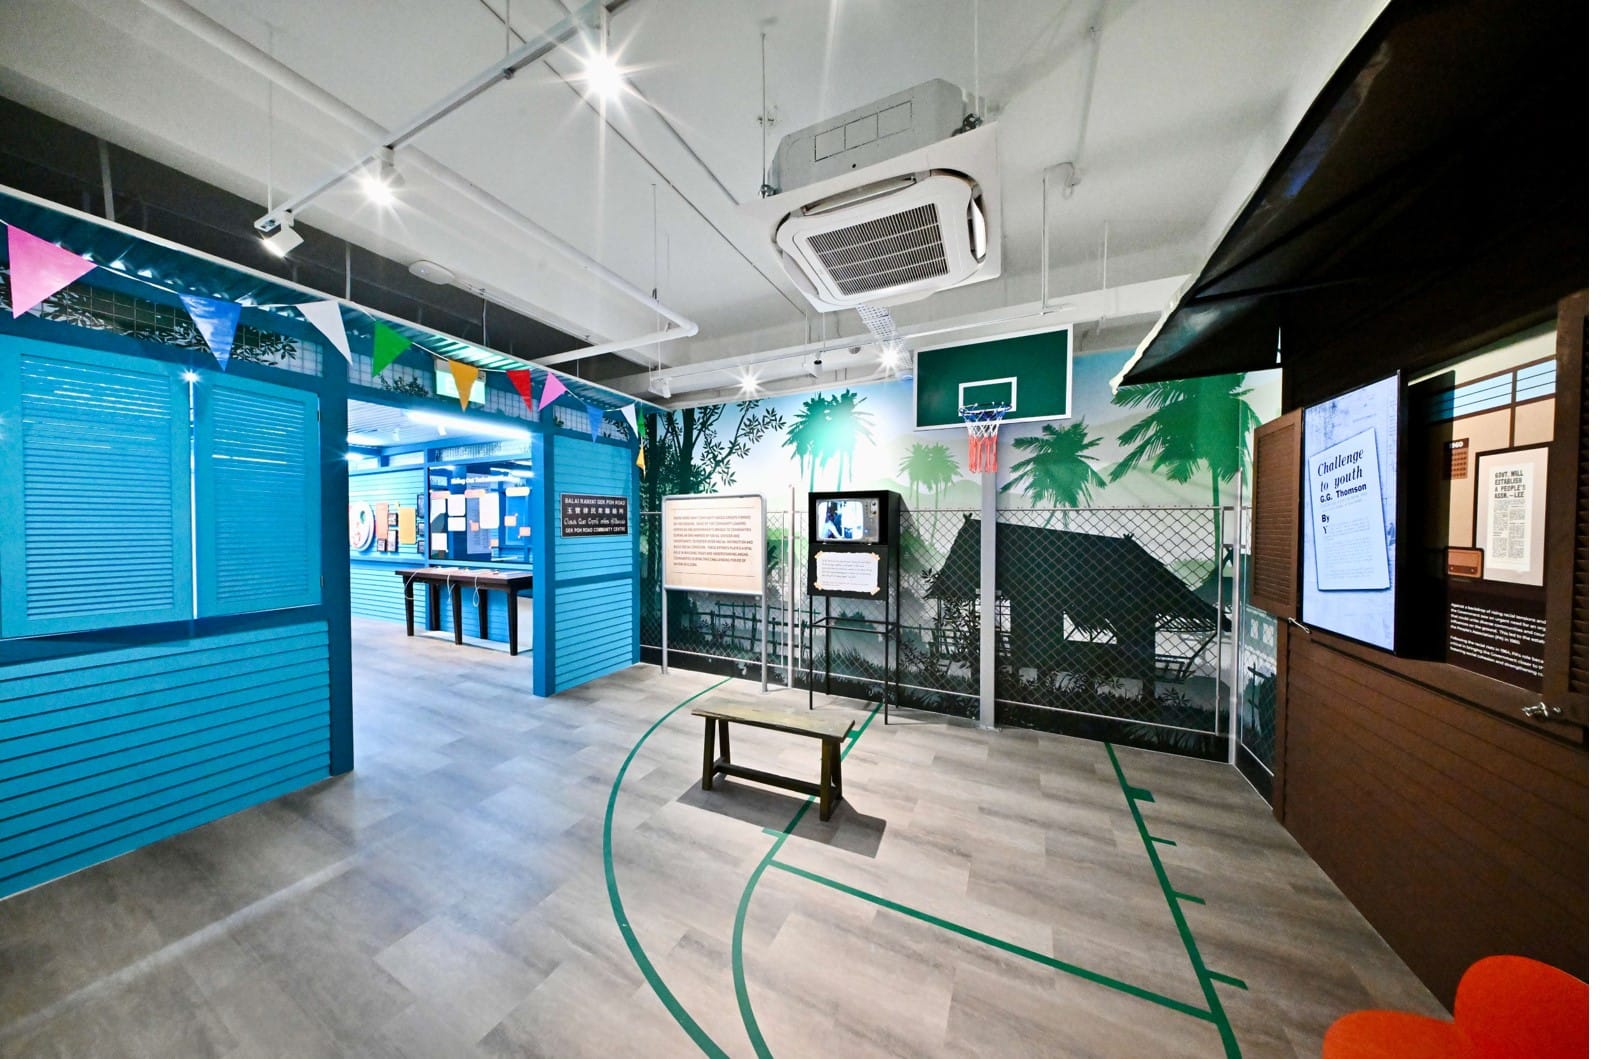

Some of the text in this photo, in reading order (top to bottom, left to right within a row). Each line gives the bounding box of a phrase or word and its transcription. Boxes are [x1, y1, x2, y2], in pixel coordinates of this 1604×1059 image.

[1317, 449, 1364, 477] Challenge
[1320, 465, 1363, 492] to youth
[1319, 483, 1367, 503] G.G. Thomson
[1321, 514, 1330, 524] By
